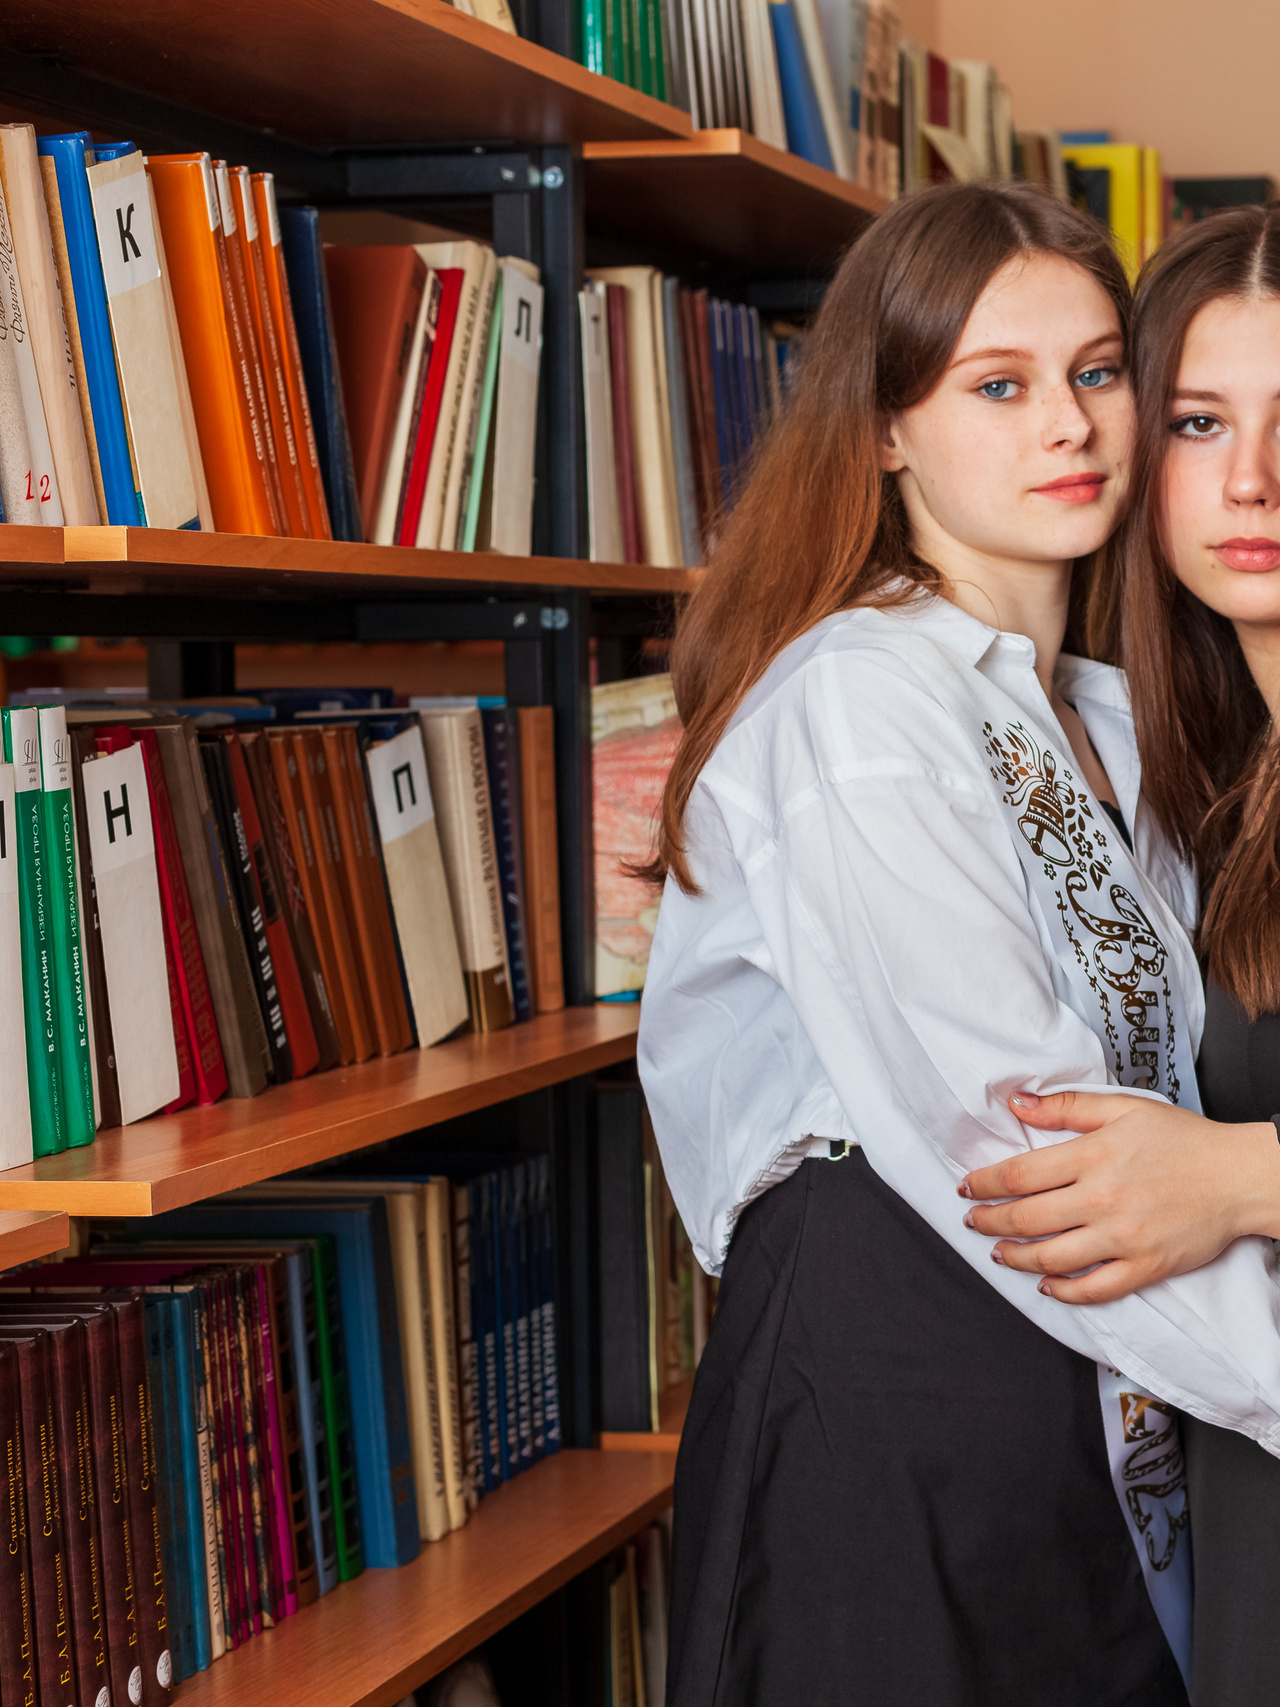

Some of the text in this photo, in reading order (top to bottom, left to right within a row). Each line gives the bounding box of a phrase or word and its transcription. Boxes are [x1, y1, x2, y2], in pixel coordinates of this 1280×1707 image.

[116, 202, 142, 263] К
[9, 274, 26, 343] Фазиль
[25, 469, 34, 500] 1
[40, 474, 51, 502] 2
[251, 418, 263, 460] СЕРГЕЙ
[104, 783, 133, 843] Н
[392, 762, 417, 814] П
[31, 804, 54, 1052] В. С. МАКАНИН ИЗБРАННАЯ ПРОЗА
[62, 802, 86, 1046] В. С. МАКАНИН ИЗБРАННАЯ ПРОЗА
[40, 1423, 53, 1536] Стихотворения
[76, 1410, 88, 1520] Стихотворения
[110, 1395, 121, 1503] Стихотворения
[138, 1383, 149, 1490] Стихотворения
[6, 1439, 18, 1554] Стихотворения
[55, 1552, 71, 1684] Б. Л. Пастернак
[89, 1536, 105, 1665] Б. Л. Пастернак
[123, 1519, 137, 1646] Б. Л. Пастернак
[152, 1505, 167, 1630] Б. Л. Пастернак
[20, 1571, 33, 1707] Б. Л. Пастернак
